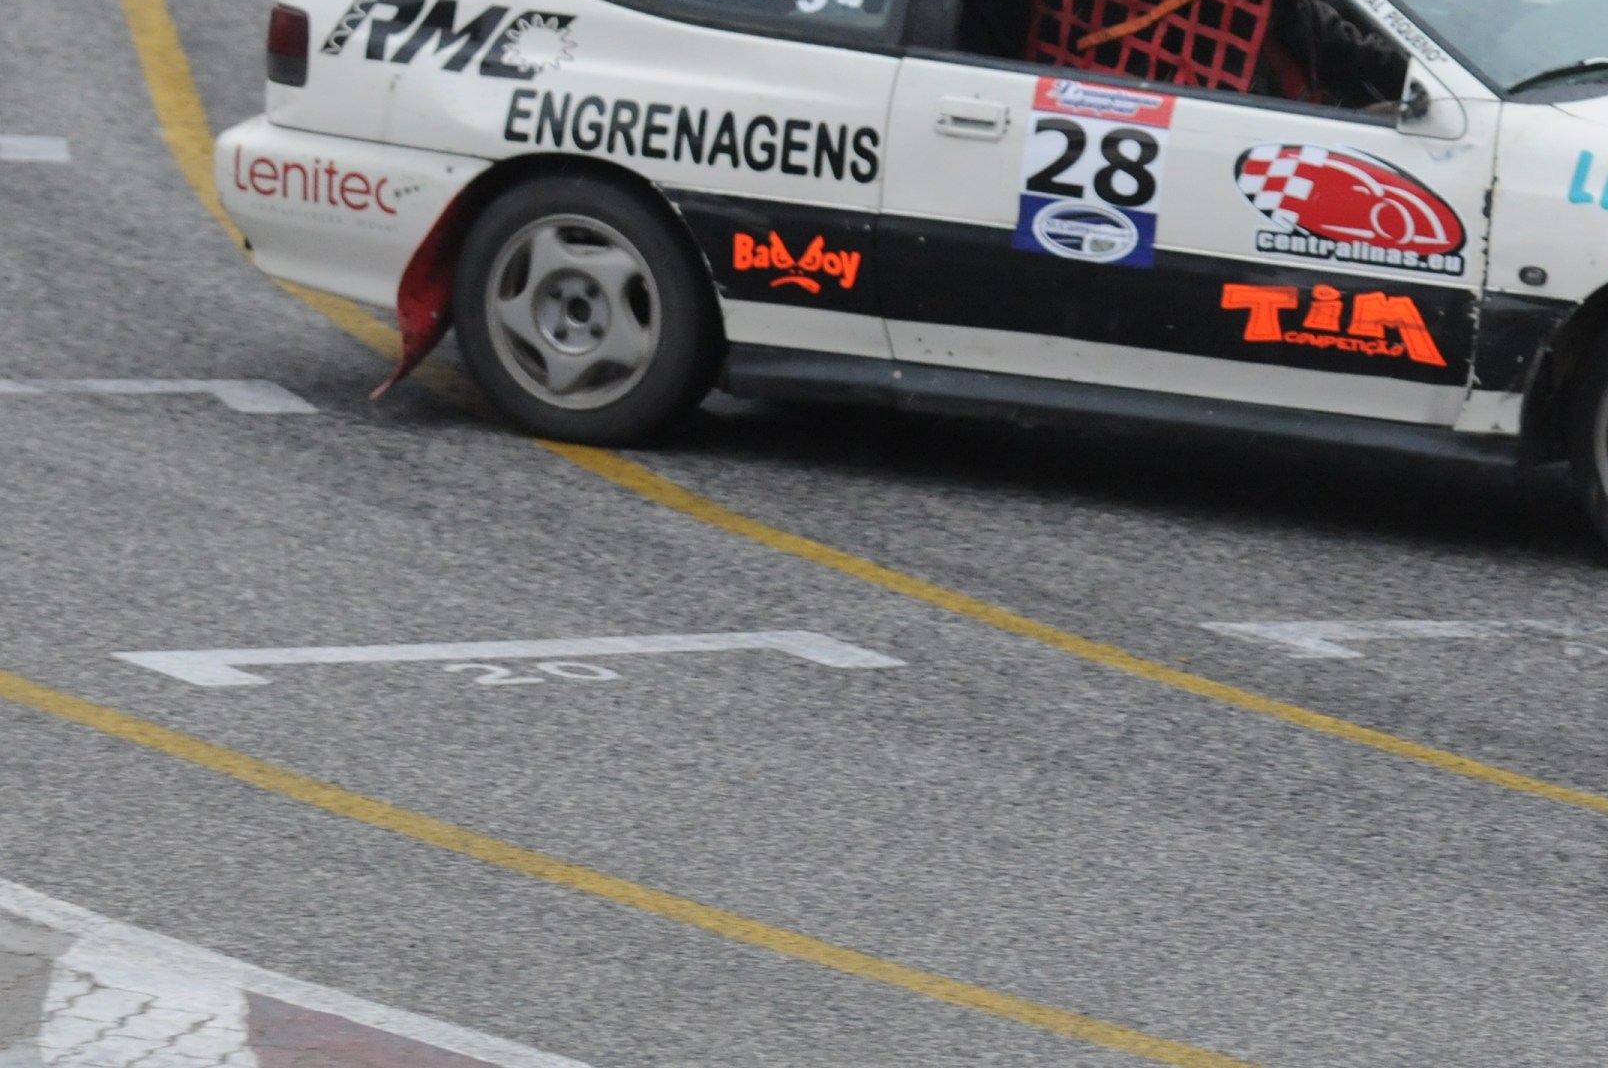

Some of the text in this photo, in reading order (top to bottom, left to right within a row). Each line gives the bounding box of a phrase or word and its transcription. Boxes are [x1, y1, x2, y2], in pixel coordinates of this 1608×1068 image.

[504, 88, 880, 185] ENGRENAGENS
[1025, 117, 1160, 208] 28
[1256, 231, 1464, 274] centralinas.eu
[444, 661, 621, 685] 20
